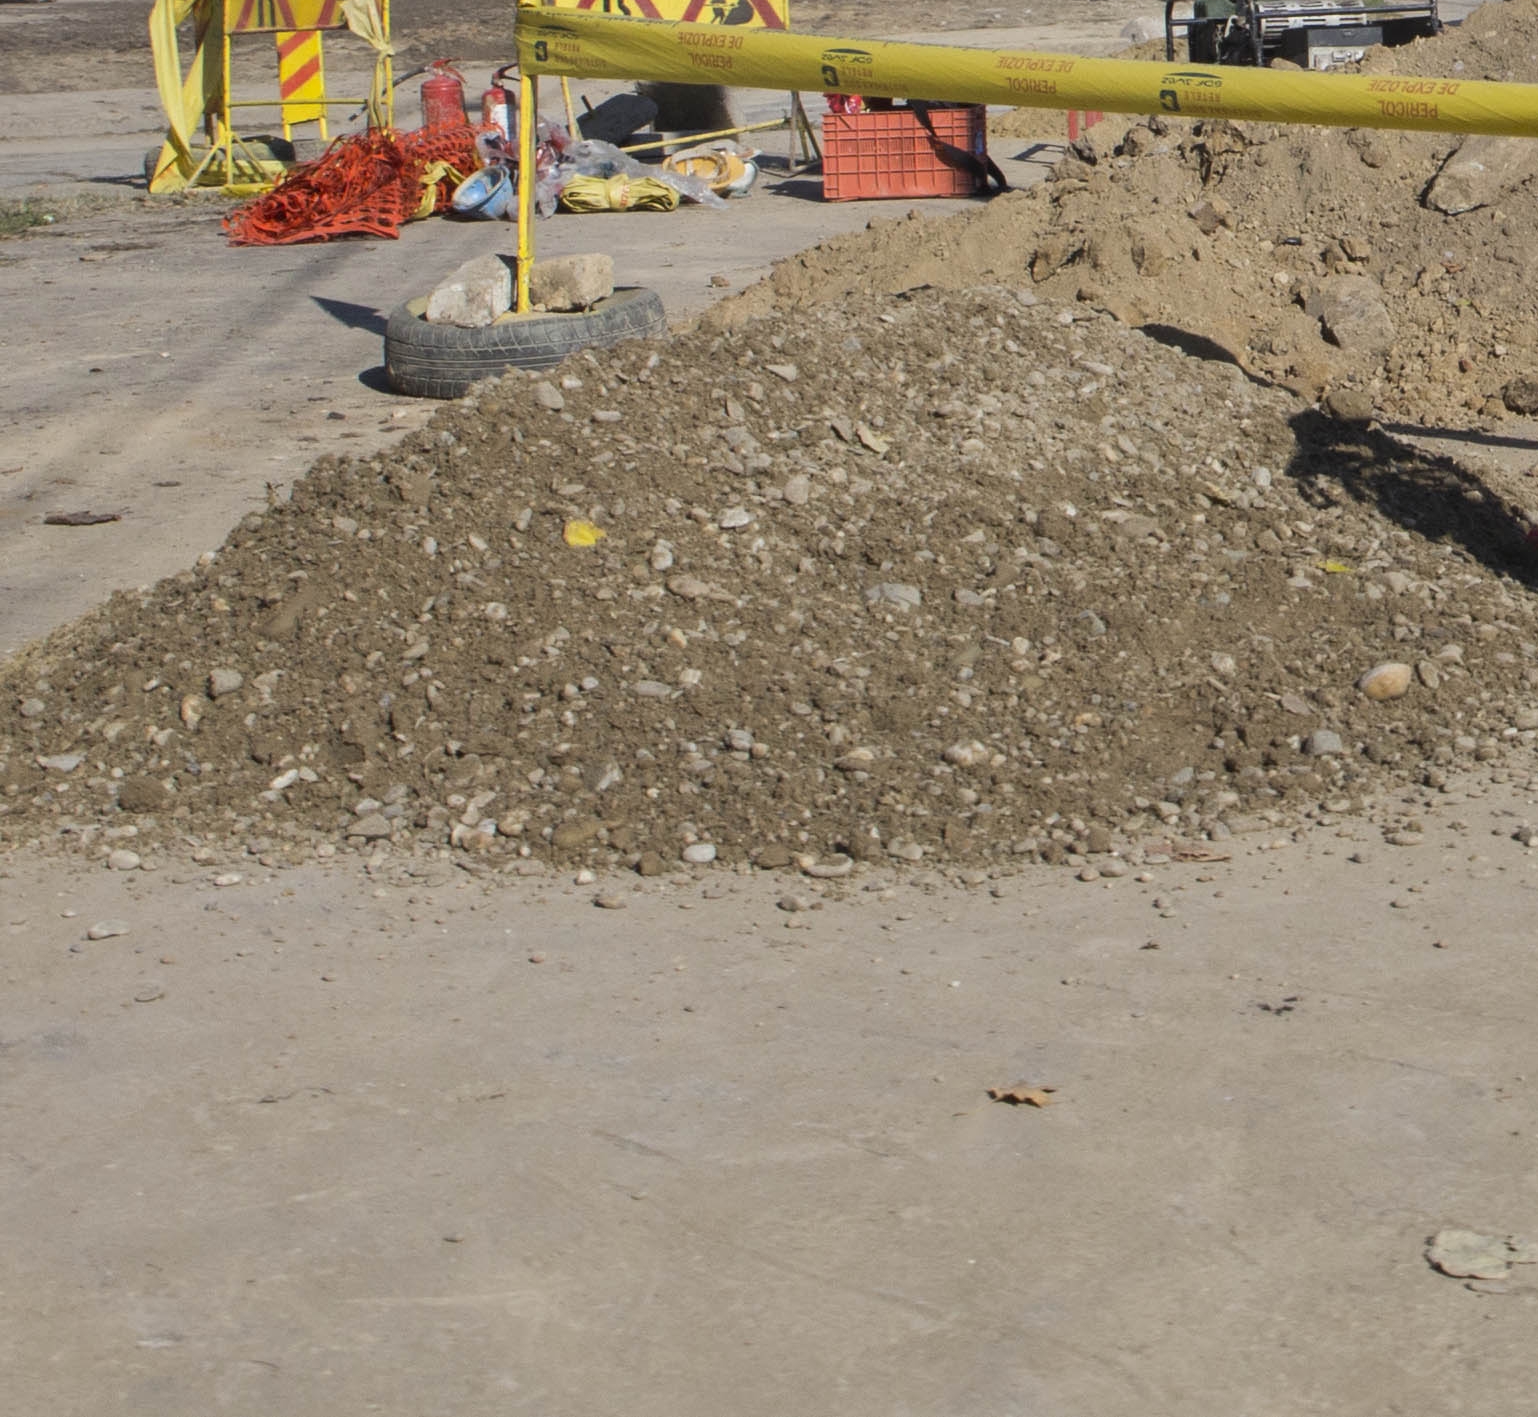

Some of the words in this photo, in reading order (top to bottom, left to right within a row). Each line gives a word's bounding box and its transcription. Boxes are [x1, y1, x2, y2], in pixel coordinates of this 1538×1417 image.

[996, 55, 1054, 73] EXPLOZIE
[1055, 59, 1074, 74] DE
[1004, 76, 1057, 95] PERICOL
[1367, 78, 1438, 95] EXPLOZIE
[1437, 82, 1460, 95] DE
[1376, 99, 1439, 119] PERICOL
